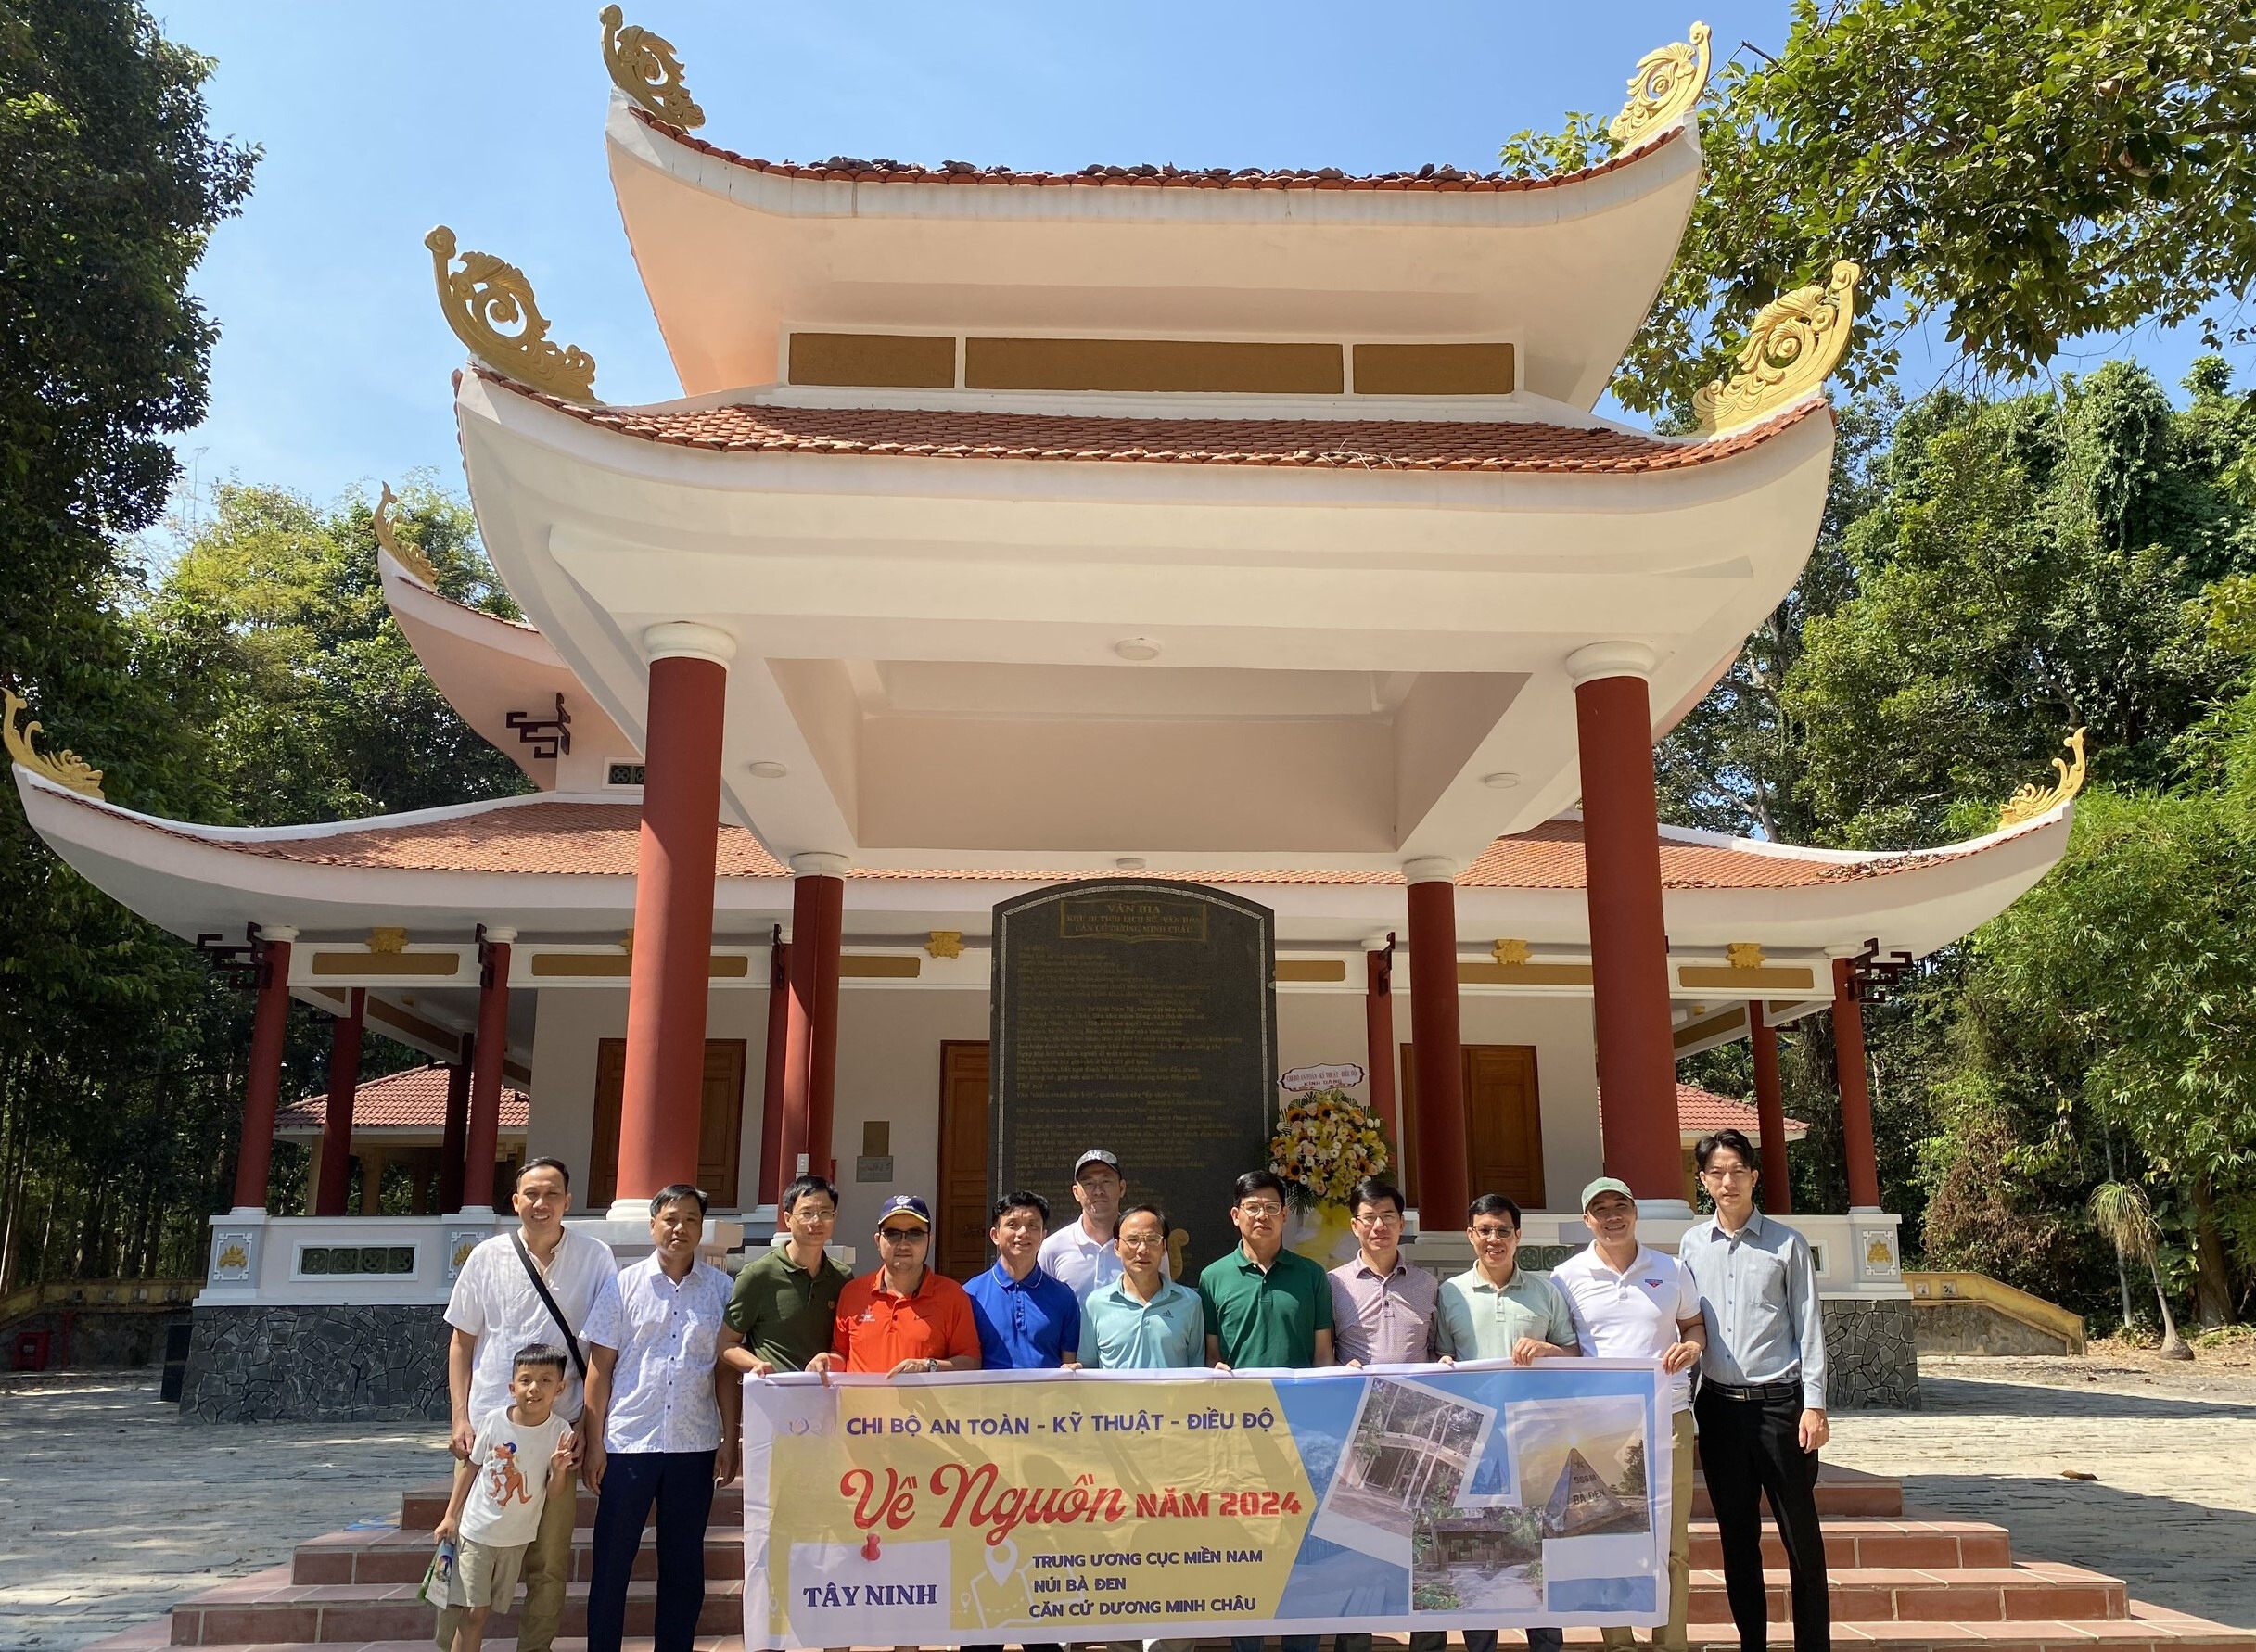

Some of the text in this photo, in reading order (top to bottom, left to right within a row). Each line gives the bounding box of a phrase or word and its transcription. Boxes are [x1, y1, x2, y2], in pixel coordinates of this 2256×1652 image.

[846, 1417, 882, 1435] CHI
[890, 1414, 922, 1437] BỘ
[929, 1418, 960, 1435] AN
[967, 1413, 1029, 1435] TOÀN
[1052, 1411, 1083, 1433] KỸ
[1091, 1409, 1164, 1435] THUẬT
[1187, 1406, 1234, 1430] ĐIỀU
[1242, 1406, 1275, 1433] ĐỘ
[840, 1462, 1303, 1546] Về Nguồn NĂM 2024
[1032, 1546, 1263, 1569] TRUNG ƯƠNG CỤC MIỀN NAM
[803, 1582, 937, 1608] TÂY NINH
[1034, 1575, 1127, 1593] NÚI BÀ ĐEN
[1029, 1595, 1256, 1618] CĂN CỨ DƯƠNG MINH CHÂU
